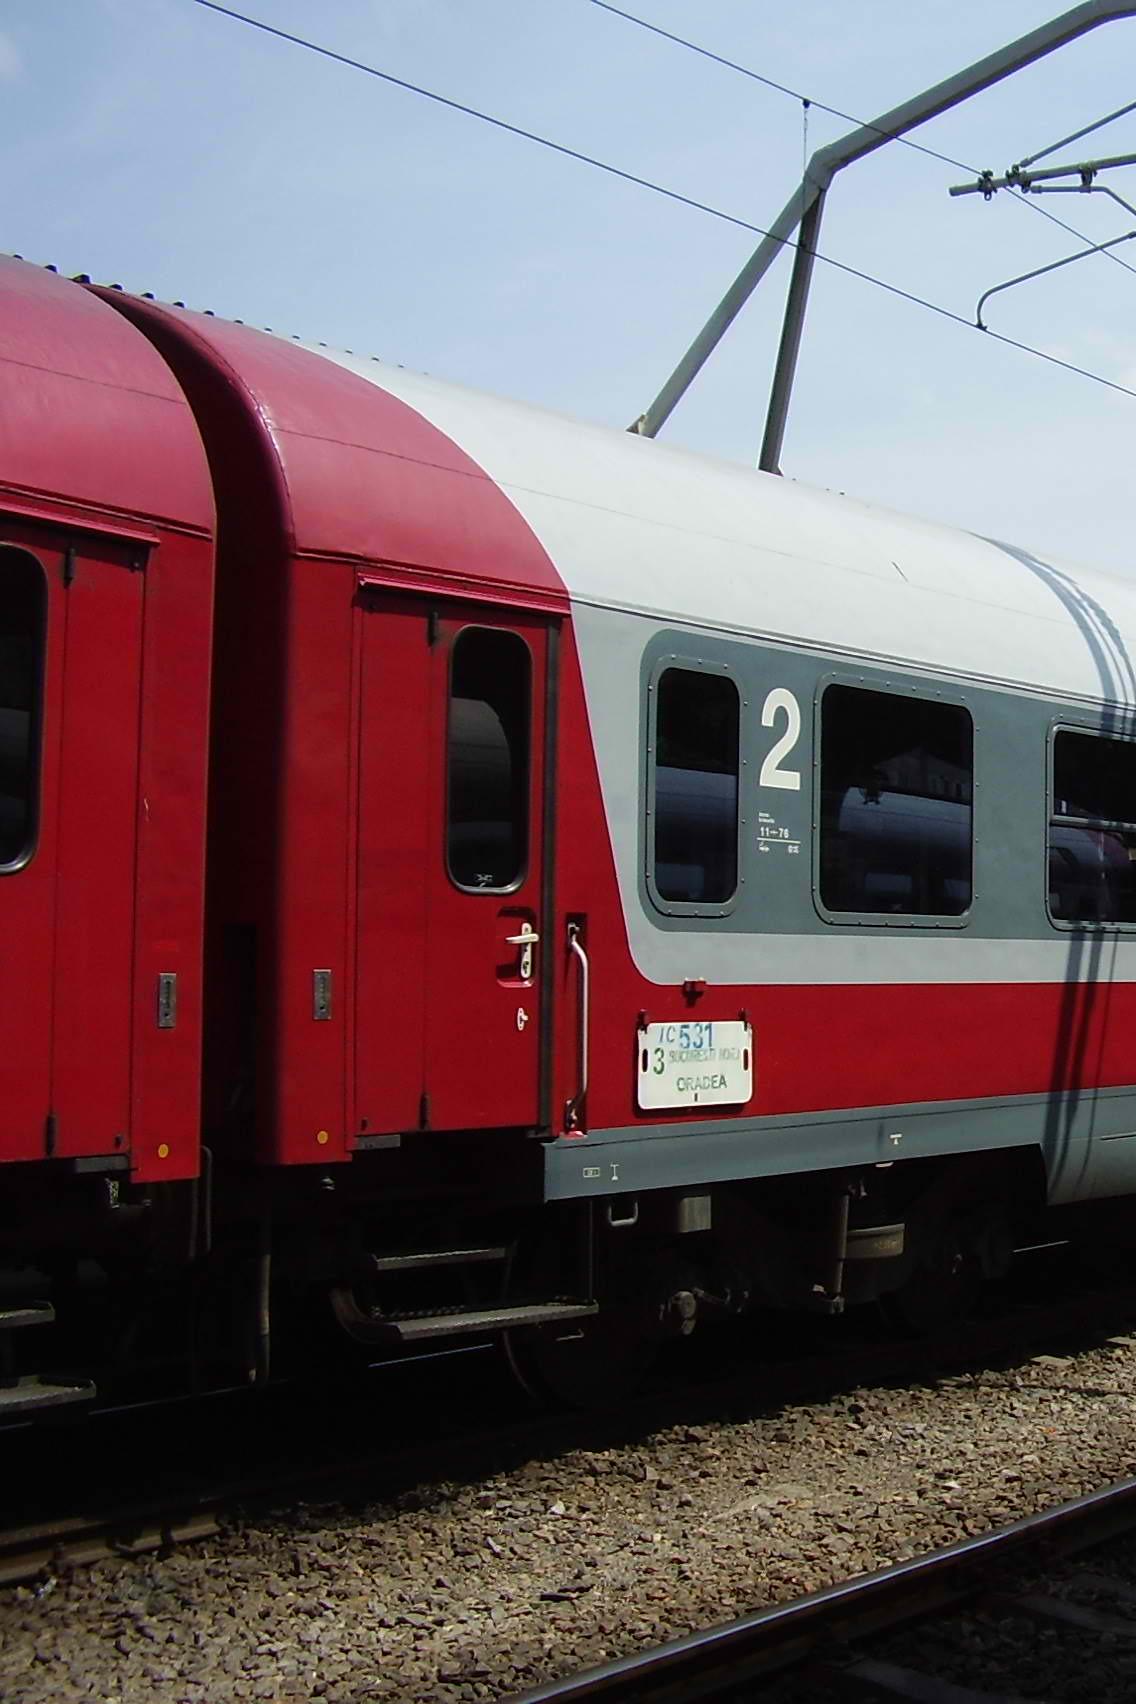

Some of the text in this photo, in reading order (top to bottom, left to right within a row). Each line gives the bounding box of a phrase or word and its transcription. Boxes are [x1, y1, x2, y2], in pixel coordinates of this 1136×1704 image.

[760, 687, 801, 791] 2
[659, 1022, 714, 1049] IC 531
[653, 1047, 665, 1075] 3
[676, 1074, 728, 1092] ORADEA
